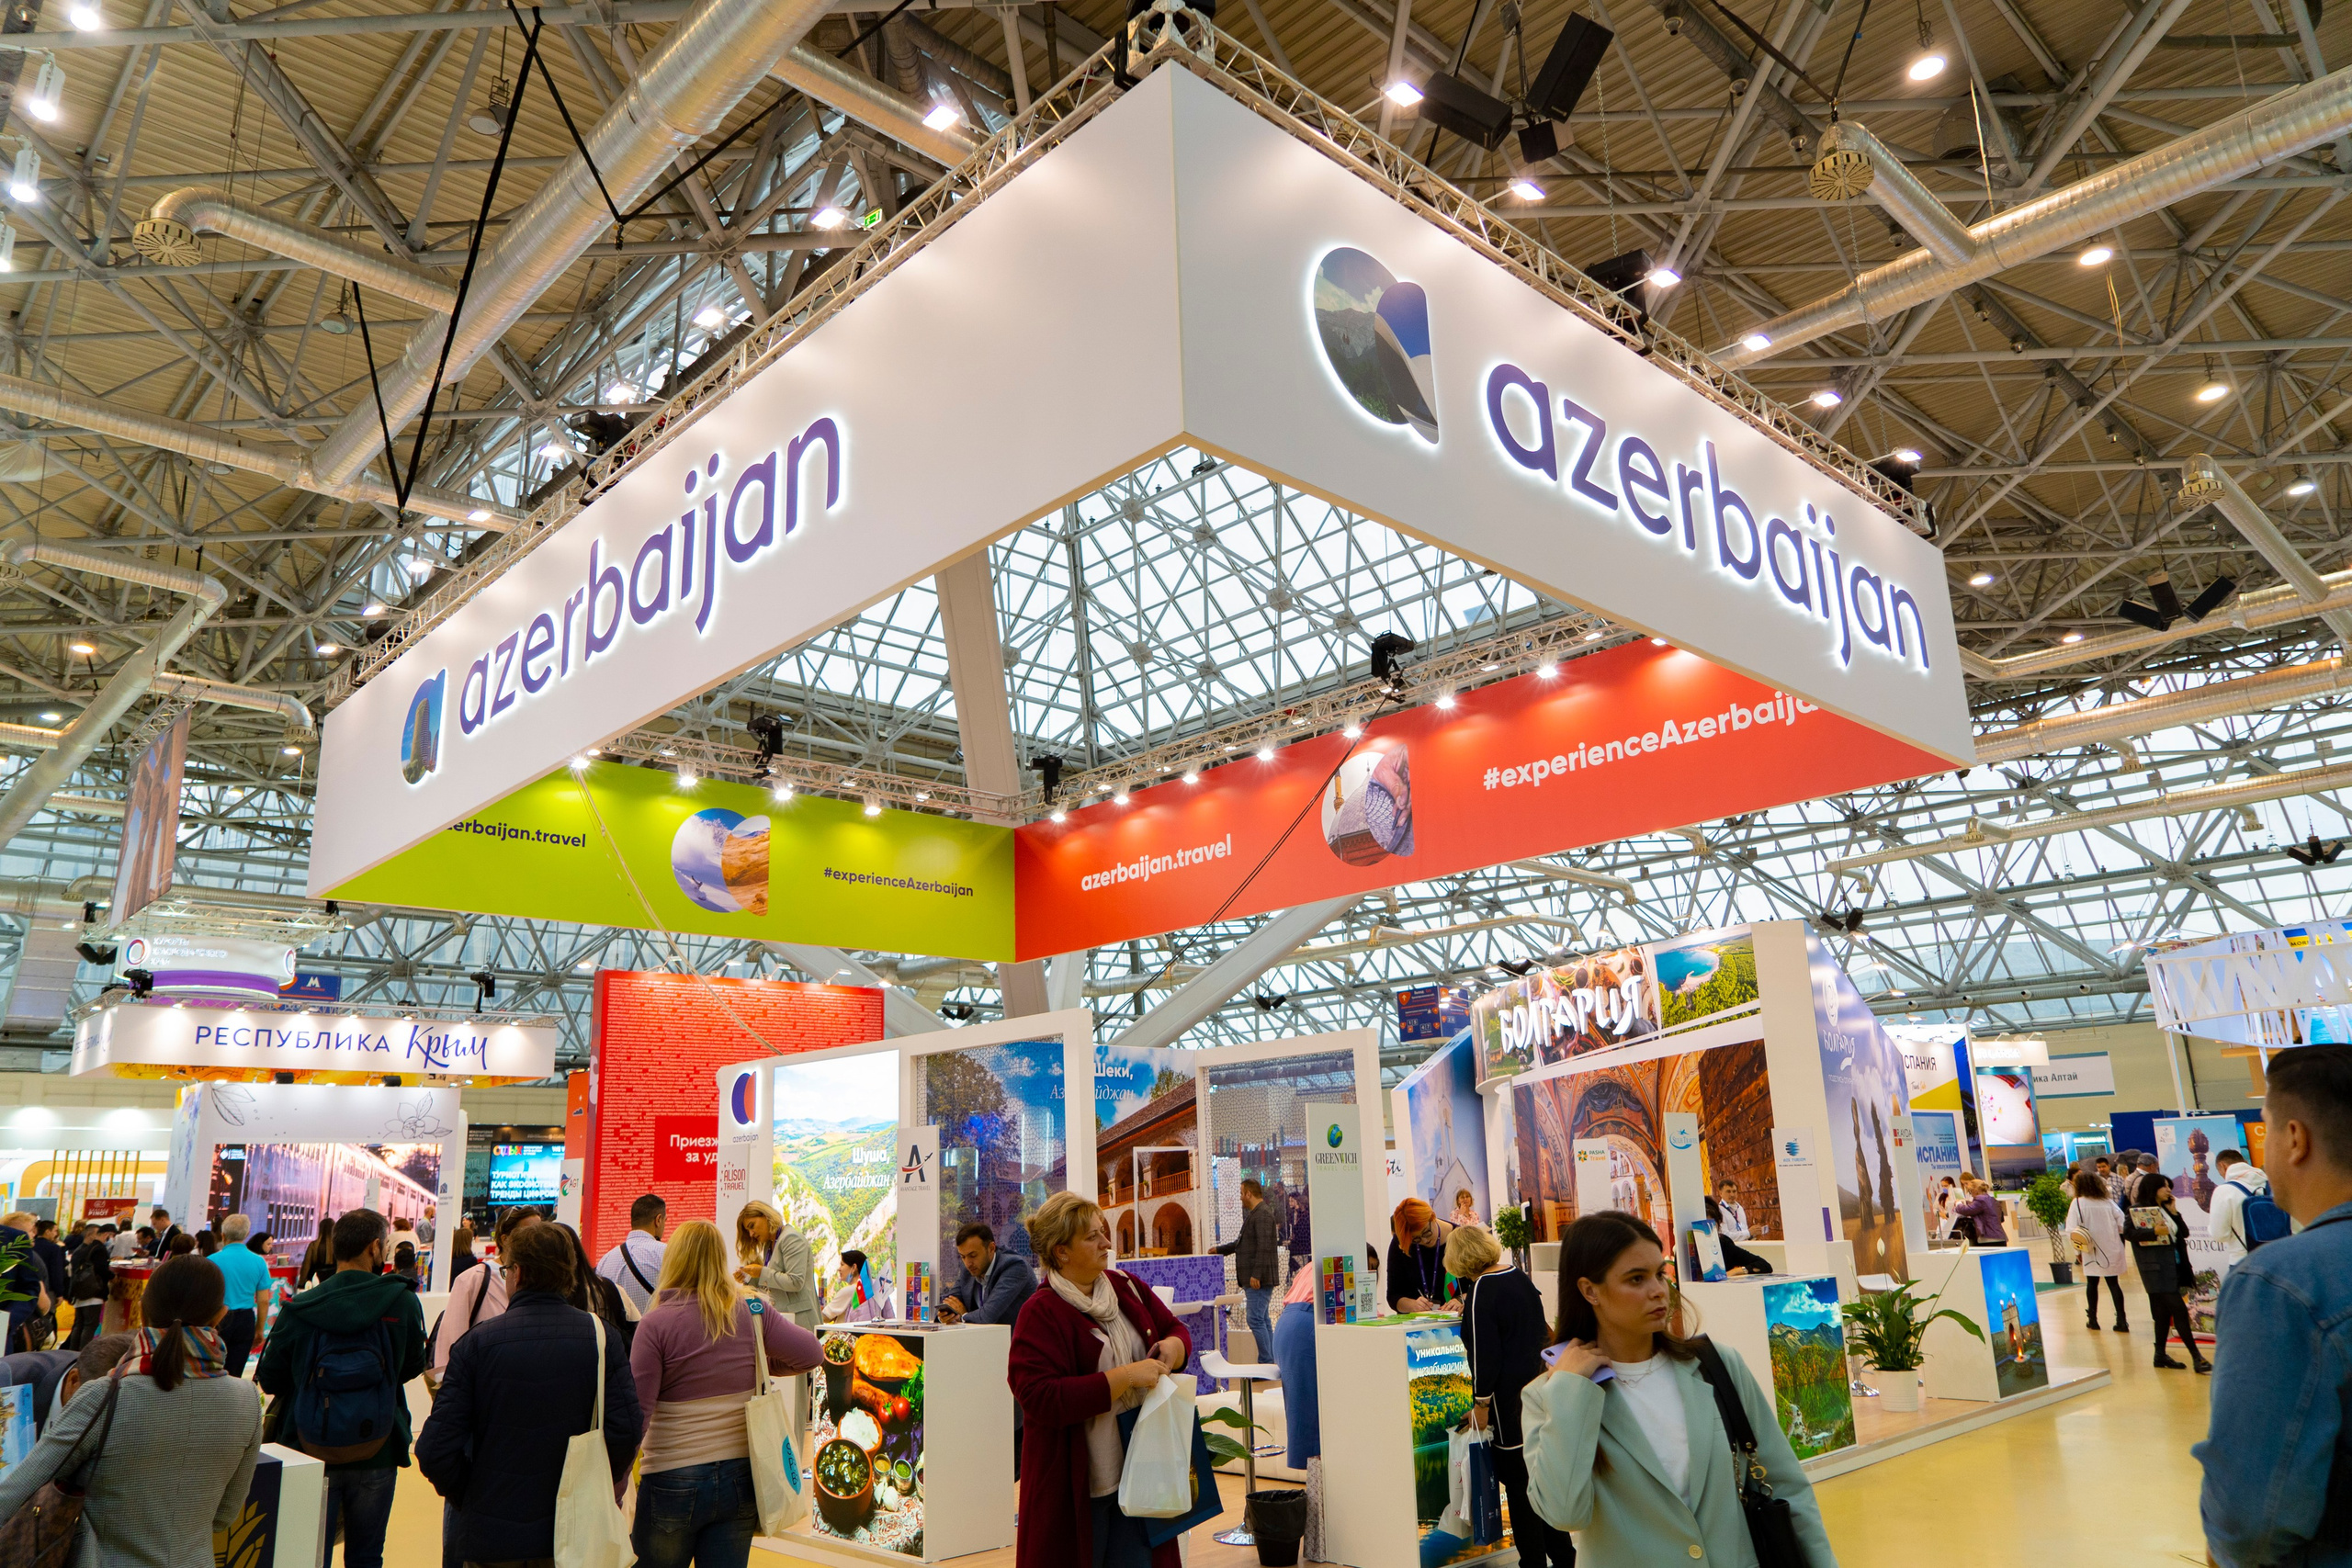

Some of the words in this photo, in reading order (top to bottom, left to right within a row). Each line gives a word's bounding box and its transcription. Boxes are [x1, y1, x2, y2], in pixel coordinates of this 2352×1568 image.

[1487, 363, 1930, 668] azerbaijan
[460, 417, 840, 635] azerbaijan
[1483, 691, 1819, 790] #experienceAzerbaija
[447, 819, 586, 847] erbaijan.travel
[1080, 833, 1232, 891] azerbaijan.travel
[823, 867, 973, 897] #experienceAzerbaijan
[1498, 975, 1645, 1054] БОЛГАРИЯ
[195, 1025, 390, 1053] РЕСПУБЛИКА
[406, 1024, 488, 1070] Крым
[1094, 1062, 1134, 1081] Шеки,
[1904, 1055, 1938, 1071] СПАНИЯ
[2051, 1071, 2078, 1082] Алтай
[670, 1134, 718, 1151] Приезж
[732, 1132, 759, 1144] azerbaijan
[492, 1145, 524, 1157] ОТДЫХ
[685, 1152, 700, 1163] за
[852, 1146, 890, 1167] Шуша,
[1315, 1152, 1358, 1165] GREENWICH
[1916, 1146, 1960, 1163] ИСПАНИЯ
[724, 1168, 746, 1182] ALISON
[823, 1170, 889, 1193] Азербайджан
[724, 1182, 745, 1190] TRAVEL
[1415, 1343, 1464, 1362] уникальная
